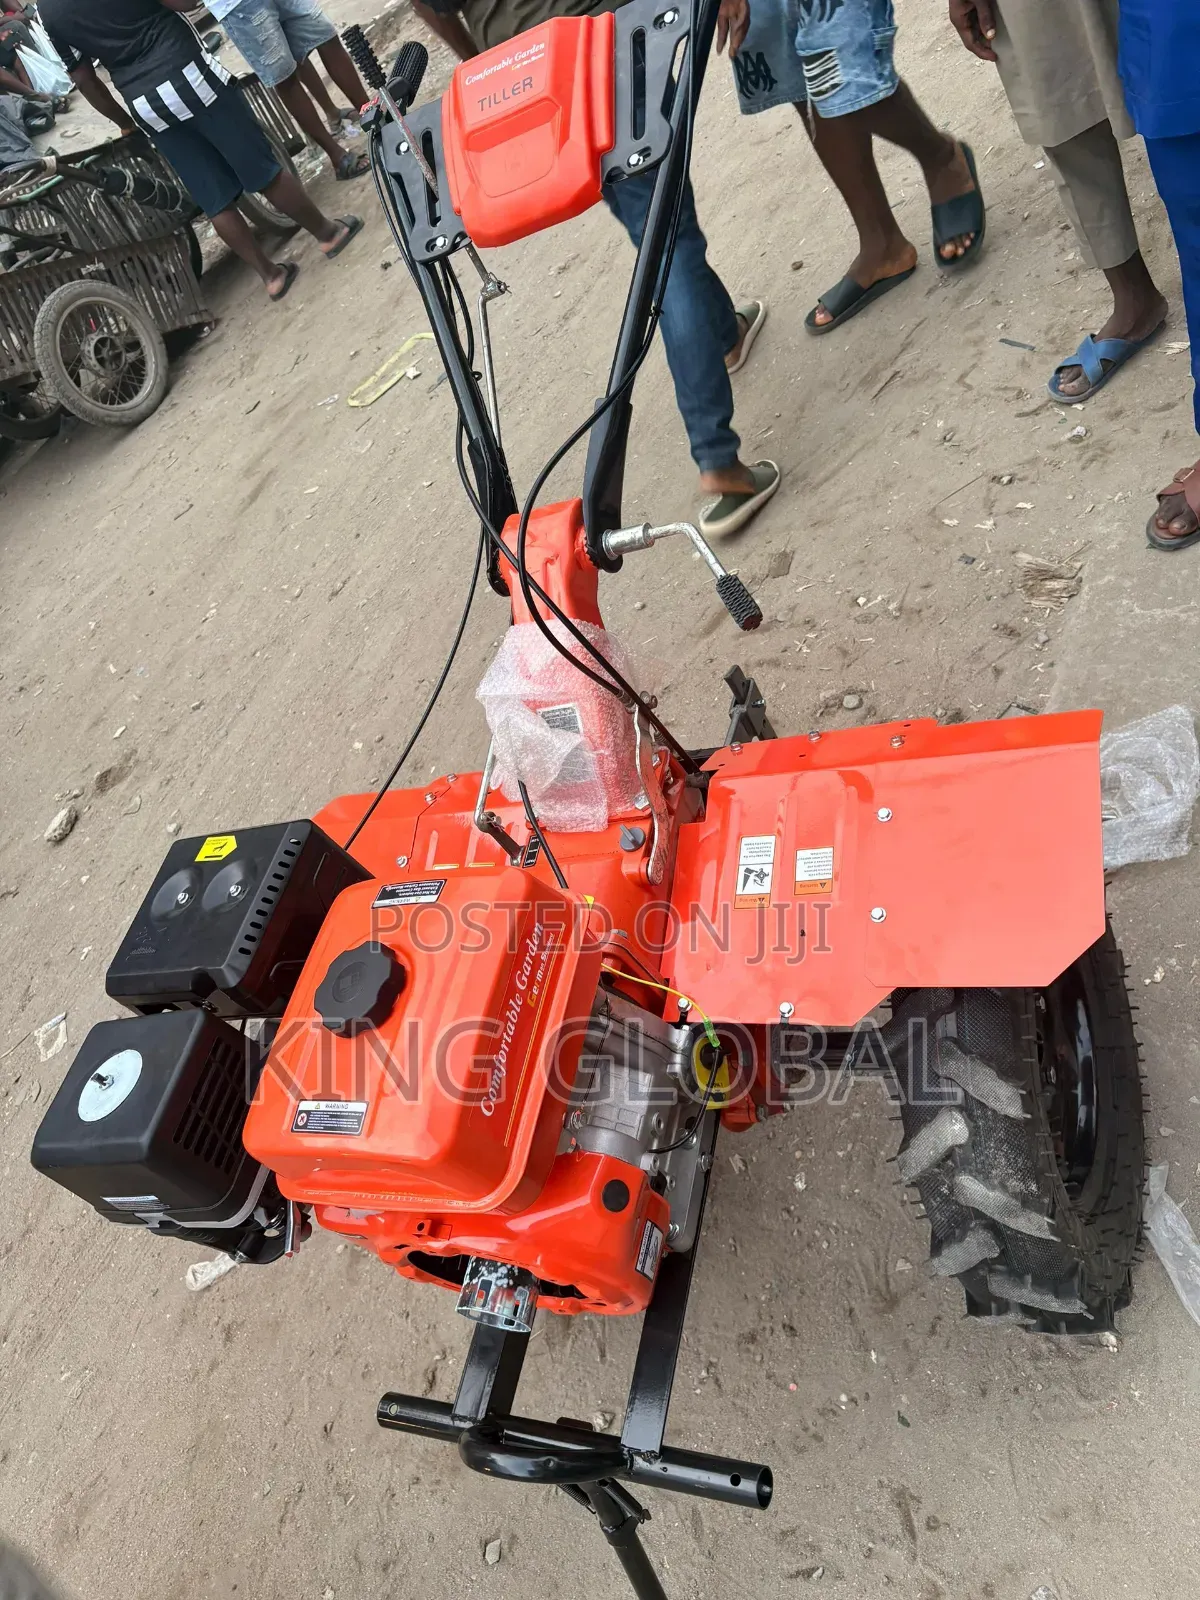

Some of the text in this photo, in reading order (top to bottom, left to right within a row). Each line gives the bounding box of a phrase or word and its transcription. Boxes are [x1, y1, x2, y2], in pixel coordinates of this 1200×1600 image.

[465, 57, 513, 85] Comfortable
[514, 43, 545, 61] Garden
[477, 76, 533, 112] TILLER
[480, 922, 543, 1117] Comfortable Garden
